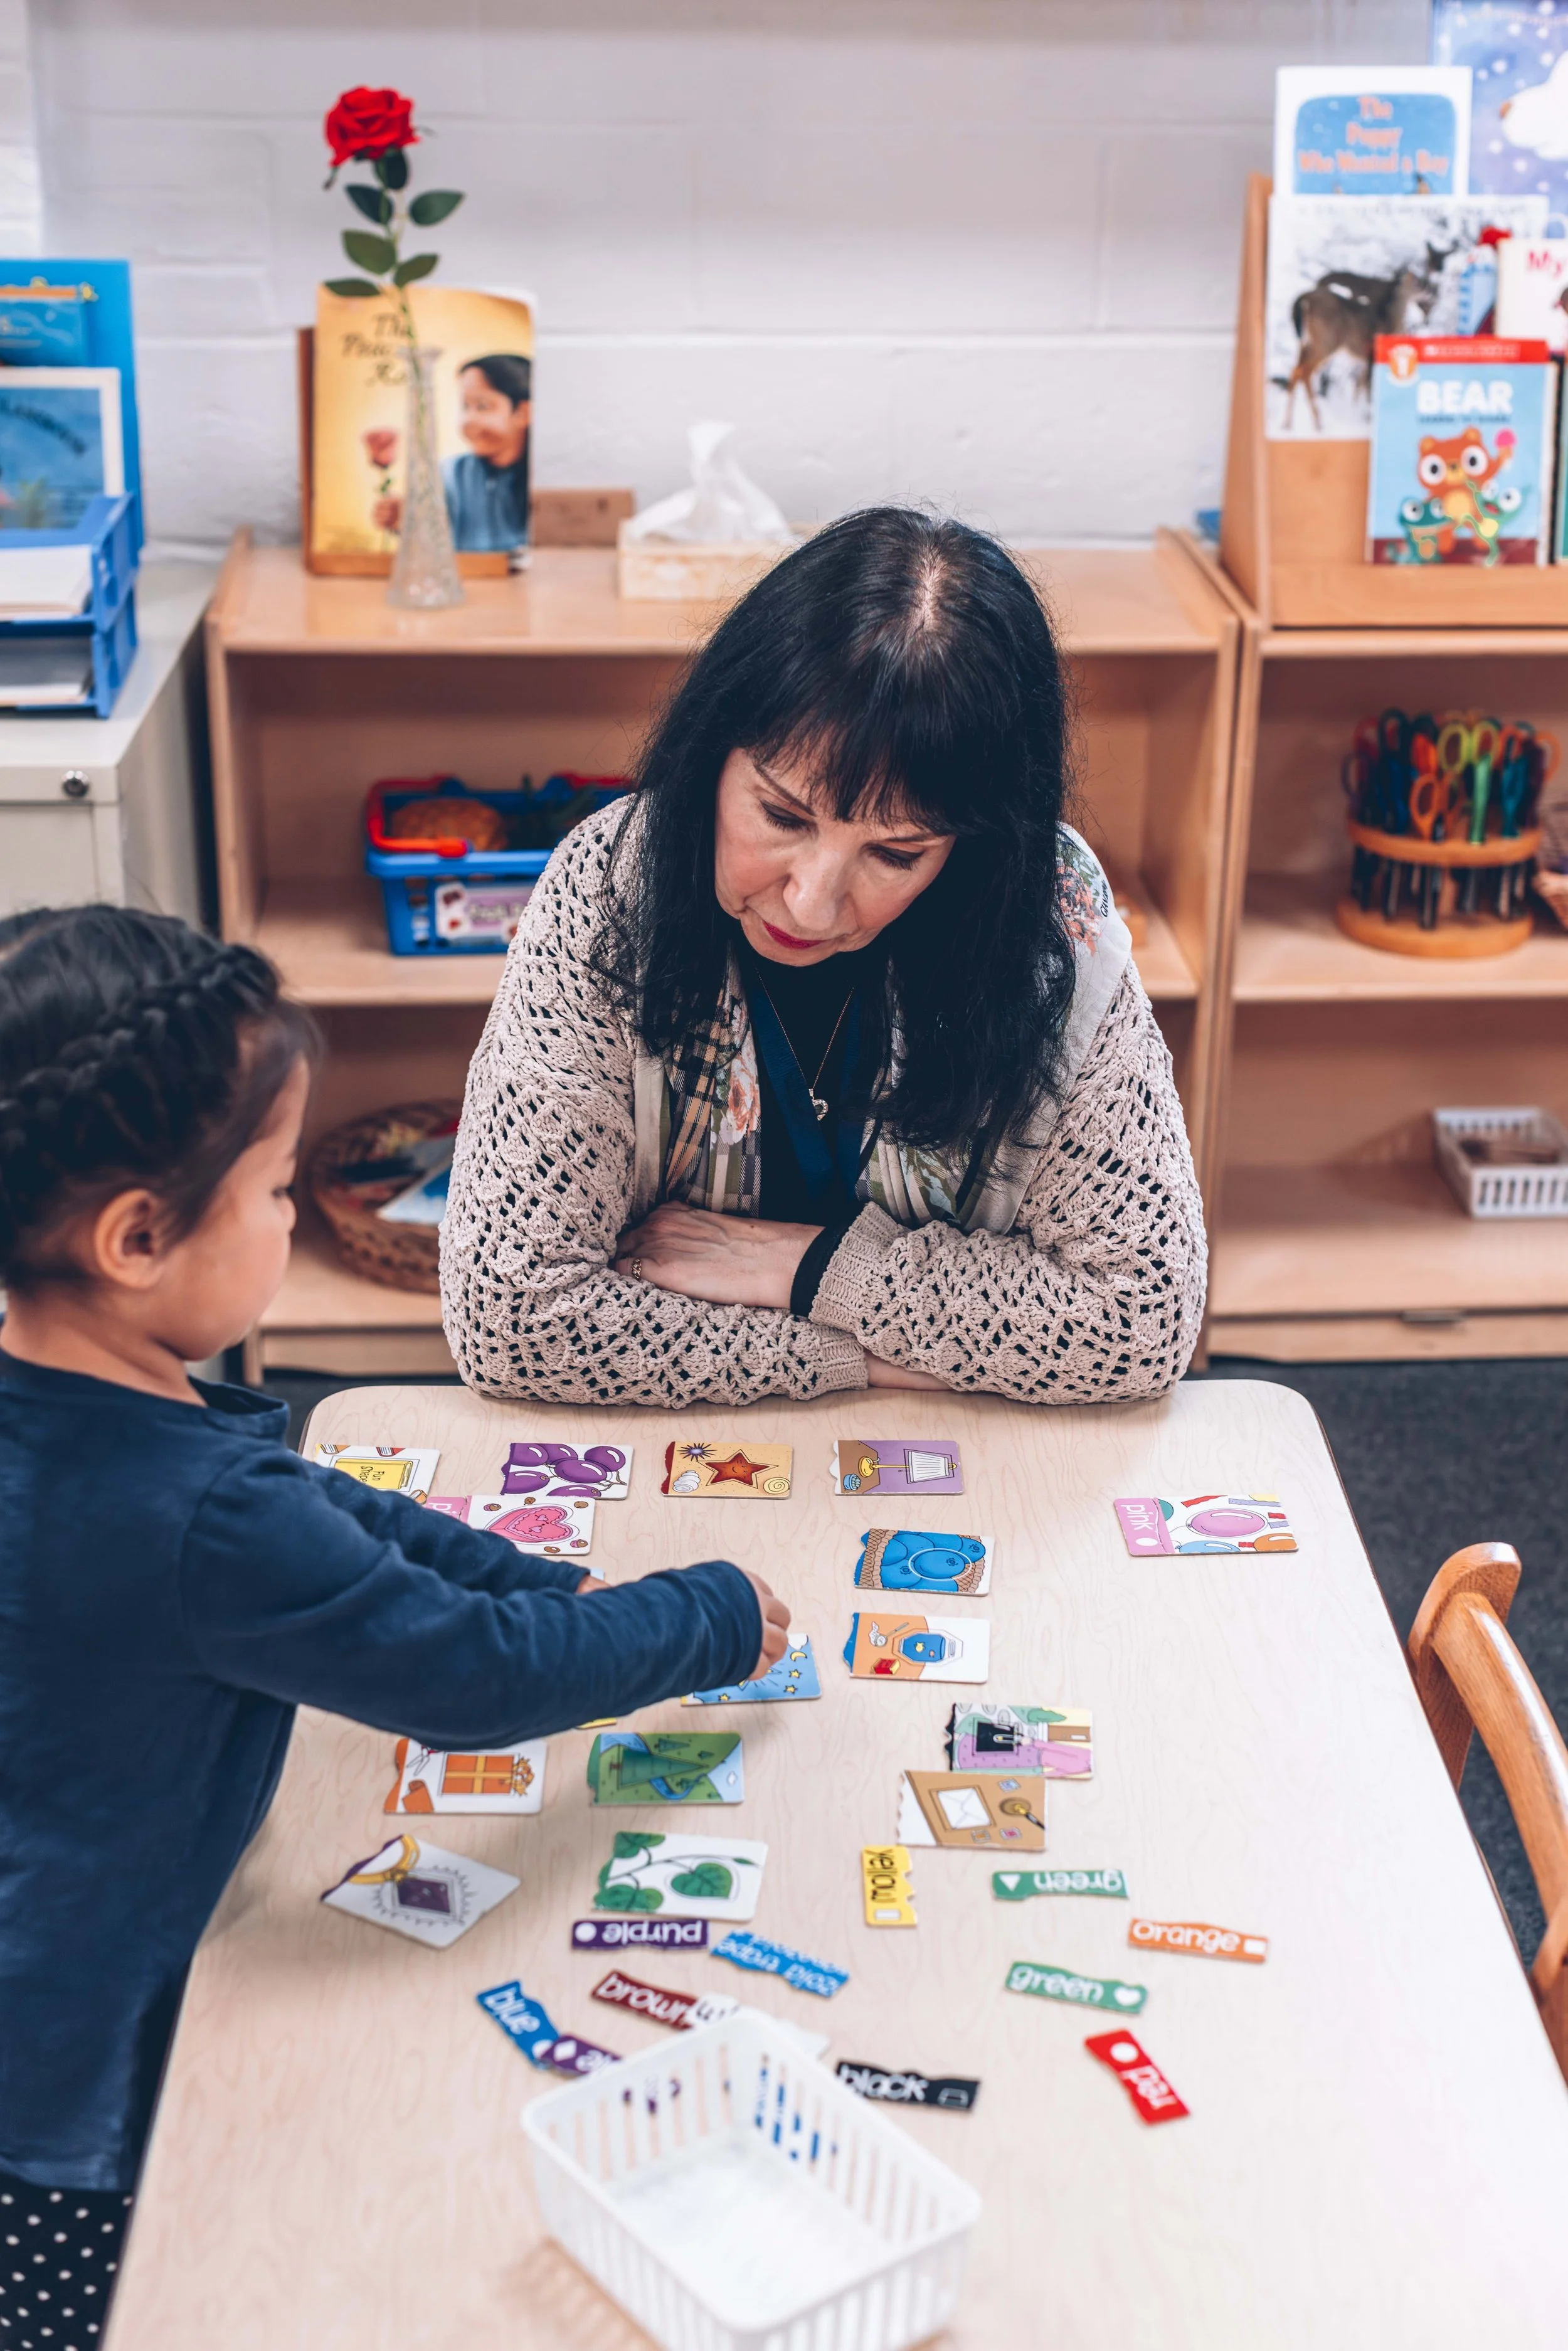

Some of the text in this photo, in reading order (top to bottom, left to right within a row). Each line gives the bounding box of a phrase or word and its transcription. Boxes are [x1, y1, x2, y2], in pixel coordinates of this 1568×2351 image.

[1416, 379, 1513, 415] BEAR
[358, 1466, 374, 1483] Shape
[372, 1471, 386, 1481] Fun
[428, 1502, 457, 1514] pi
[1120, 1504, 1155, 1531] pink
[864, 1849, 898, 1904] yellow
[1033, 1869, 1123, 1892] green
[601, 1919, 702, 1945] purple
[1133, 1919, 1240, 1953] orange
[1010, 1965, 1104, 2003] green
[484, 1987, 541, 2035] blue
[839, 2063, 928, 2101] black
[1118, 2064, 1177, 2110] red
